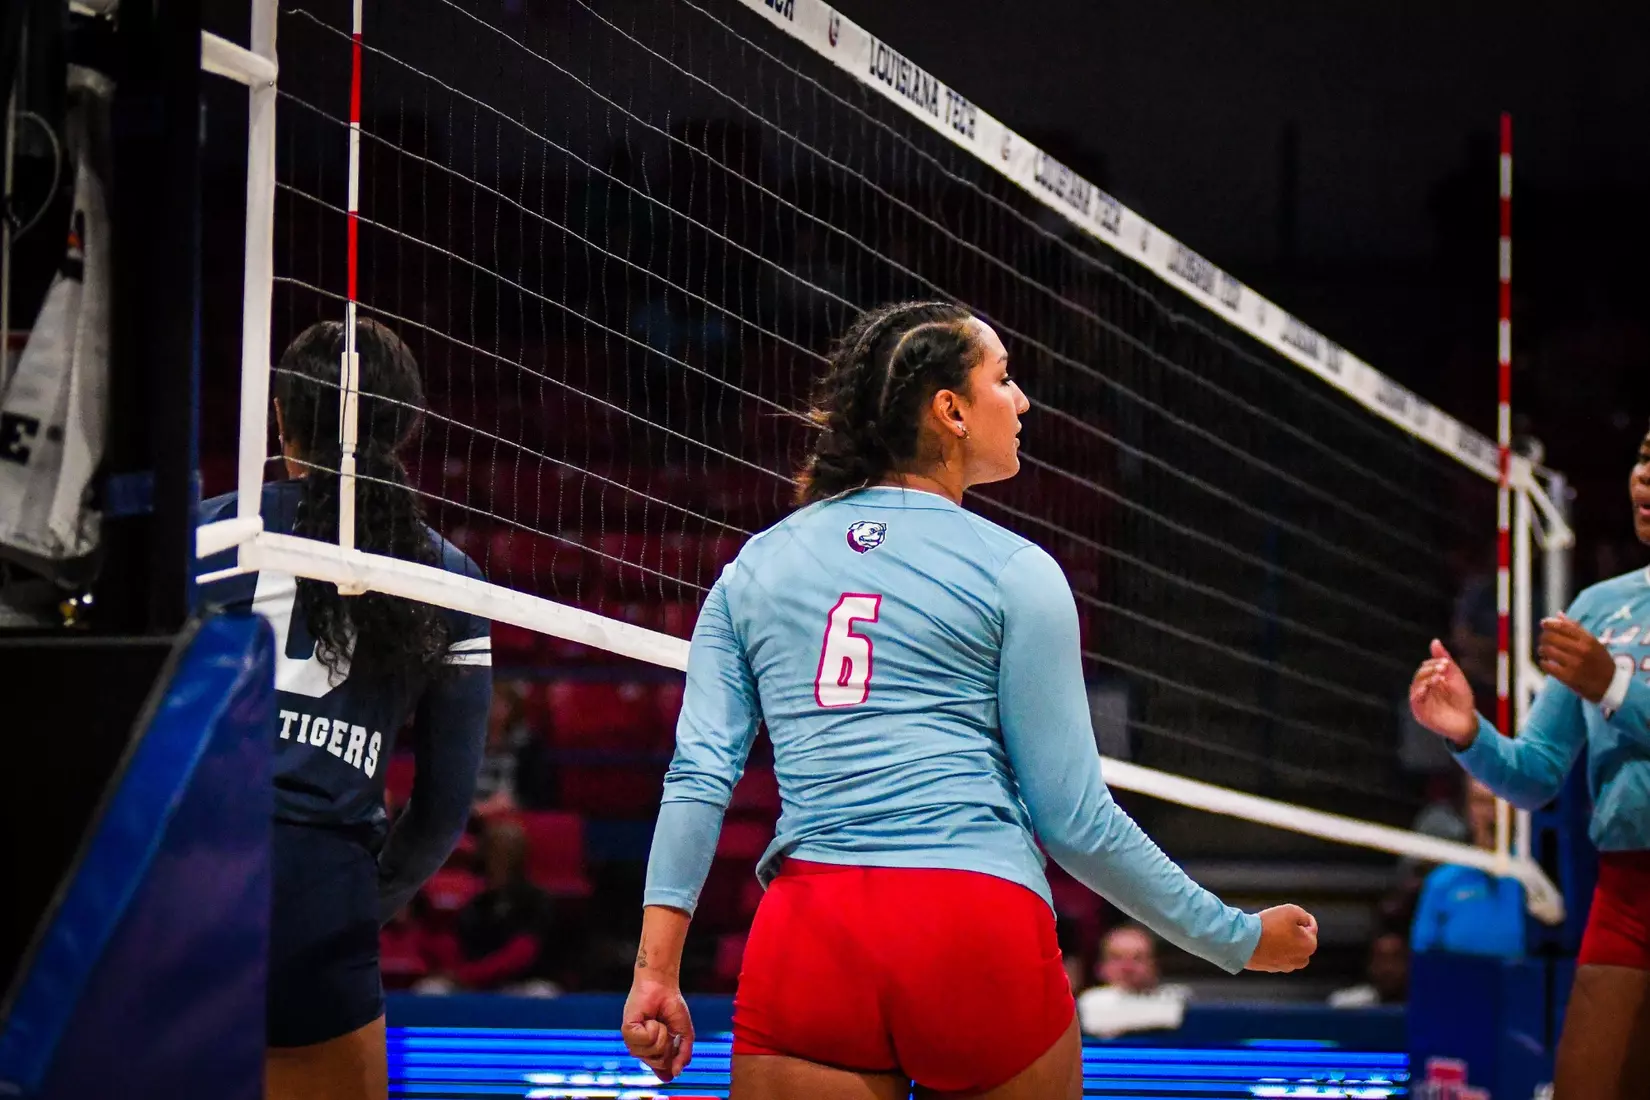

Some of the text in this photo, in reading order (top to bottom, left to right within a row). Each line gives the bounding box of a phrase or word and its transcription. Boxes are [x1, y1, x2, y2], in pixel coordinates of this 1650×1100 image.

[868, 35, 977, 140] LOUISIANA TECH
[814, 592, 882, 707] 6
[279, 709, 382, 779] TIGERS
